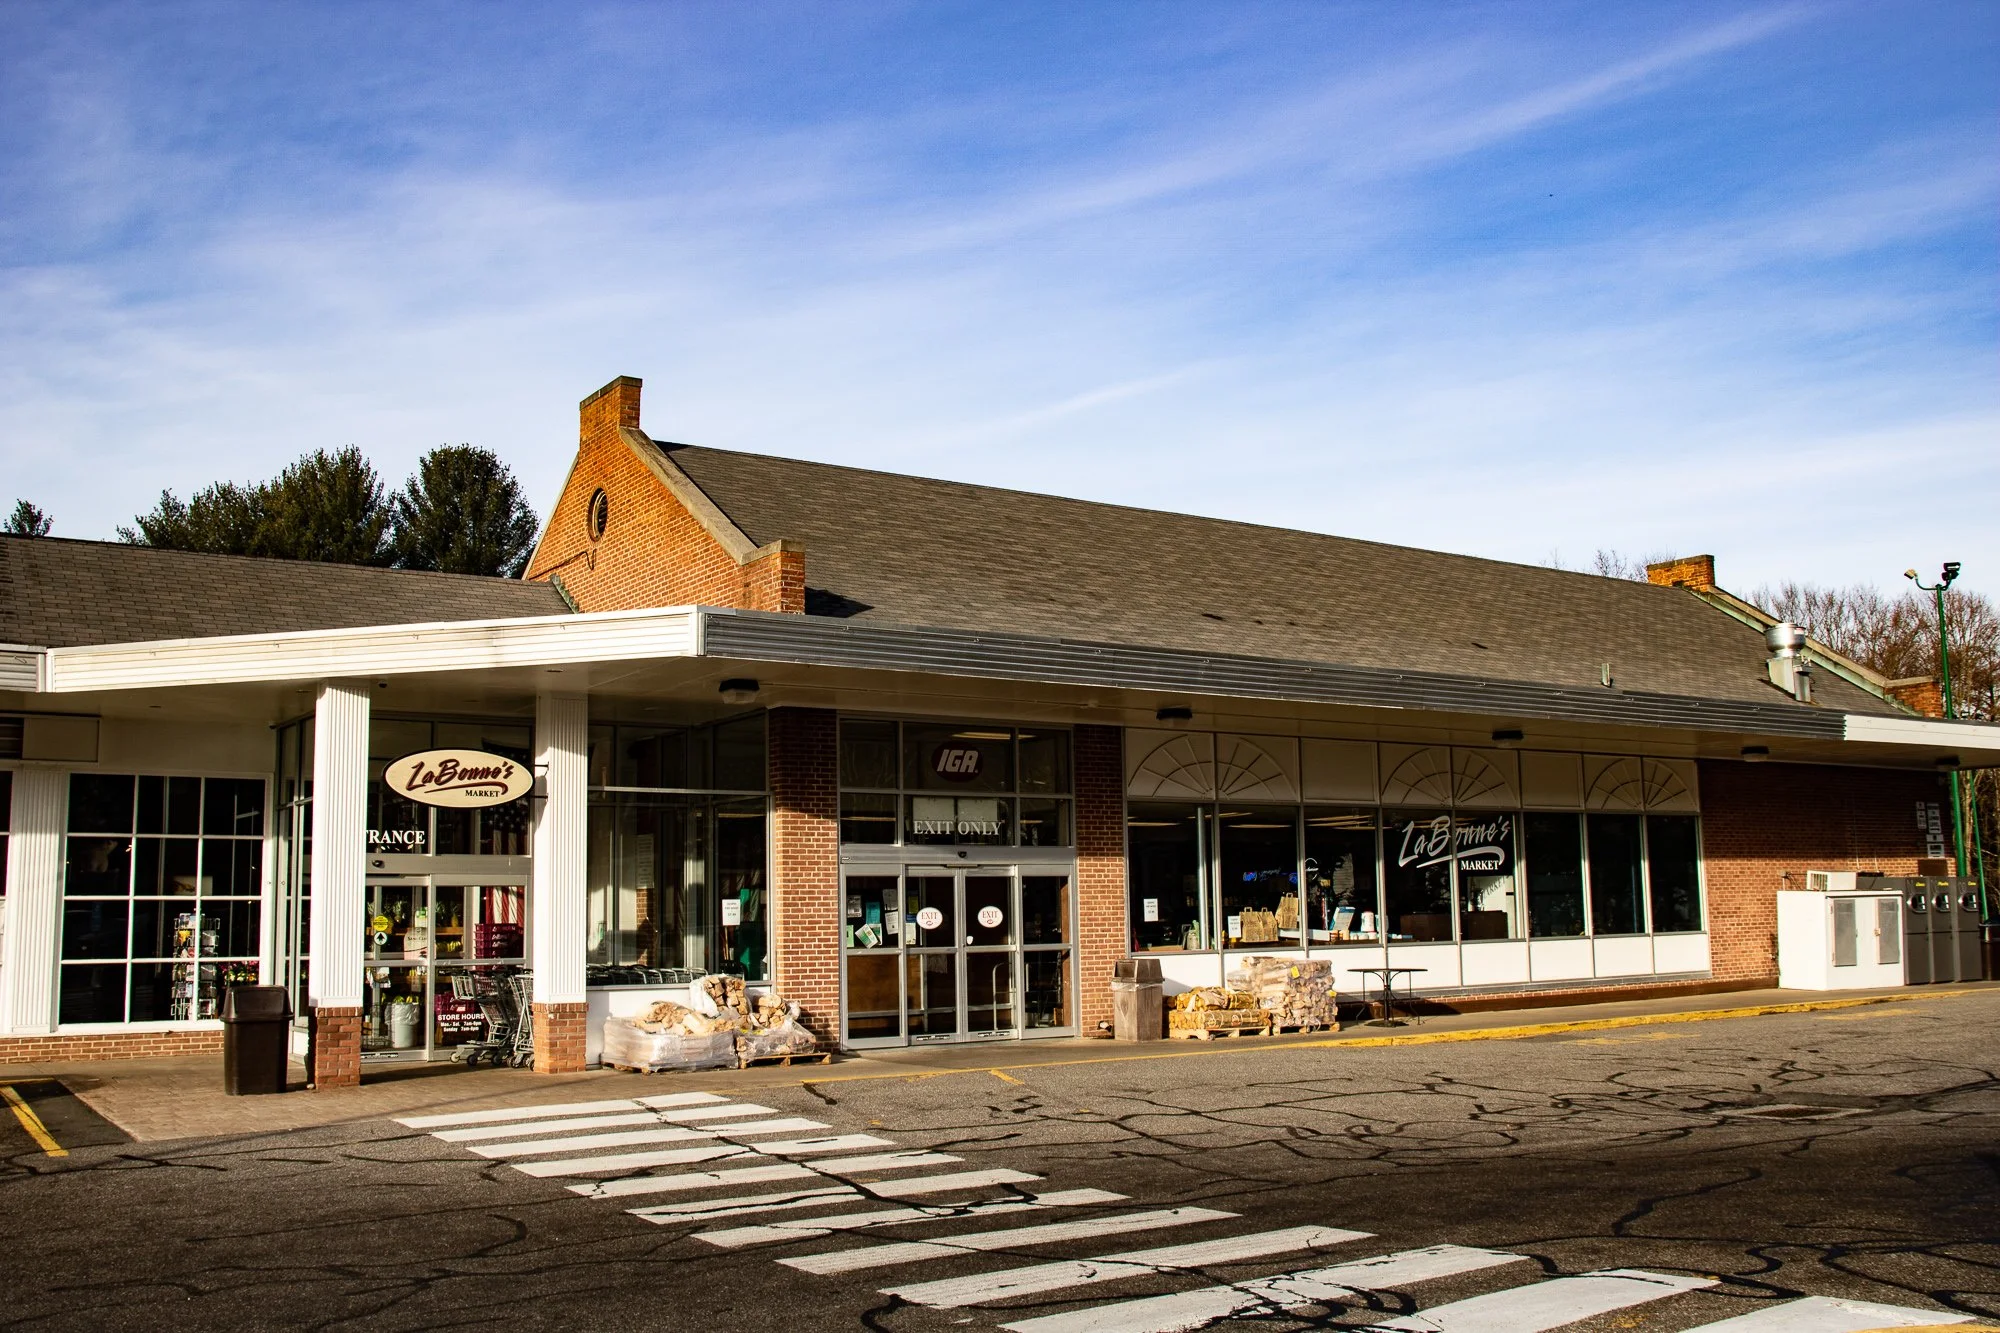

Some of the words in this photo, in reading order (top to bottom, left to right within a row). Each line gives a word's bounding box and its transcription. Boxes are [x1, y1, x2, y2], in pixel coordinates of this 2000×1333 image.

[936, 749, 979, 773] IGA
[405, 758, 515, 791] LaBonne's
[465, 790, 500, 798] MARKET
[914, 820, 954, 835] EXIT
[957, 821, 1002, 836] ONLY
[366, 829, 426, 845] RANCE
[1398, 815, 1511, 867] LaBonne's
[1461, 860, 1499, 870] MARKET
[921, 912, 938, 920] EXIT
[982, 910, 999, 919] EXIT
